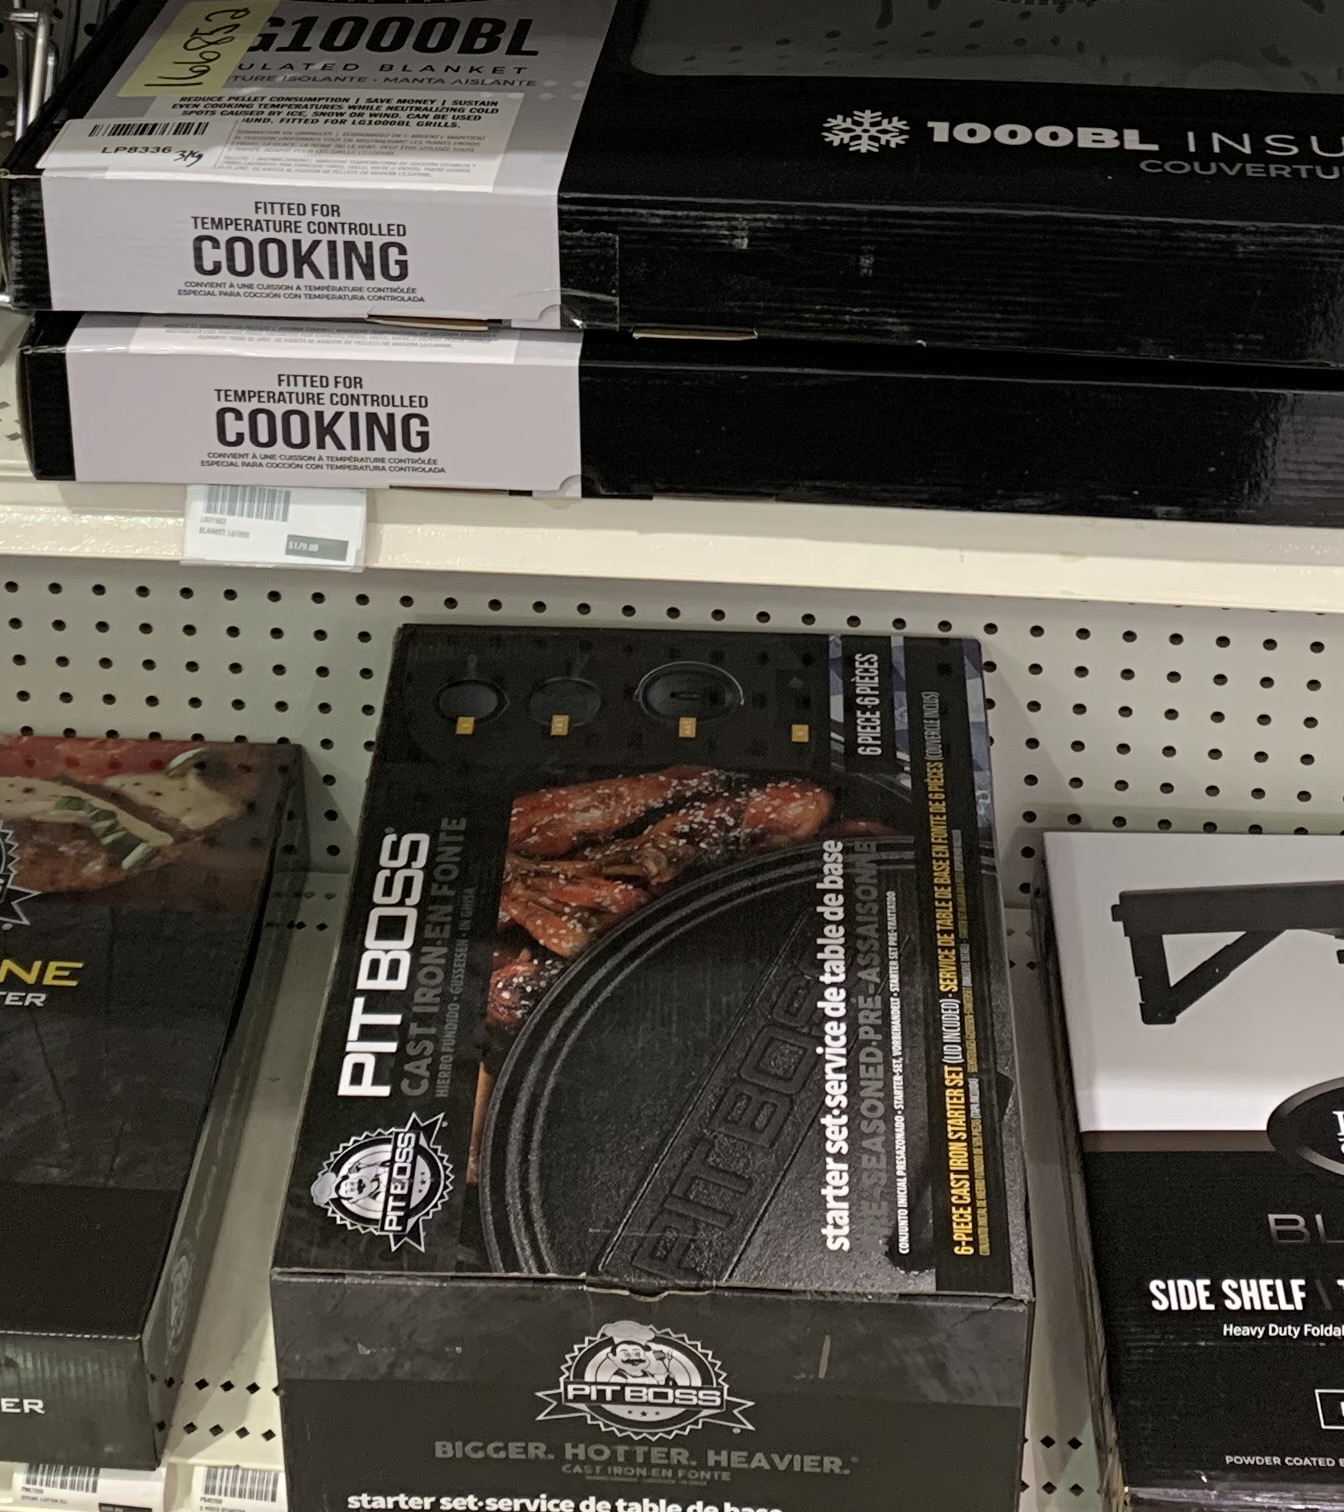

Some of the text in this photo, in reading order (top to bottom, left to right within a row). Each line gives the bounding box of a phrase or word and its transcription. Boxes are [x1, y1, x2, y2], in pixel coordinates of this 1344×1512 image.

[102, 146, 172, 155] LP8336
[926, 121, 1160, 152] 1000BL
[254, 202, 341, 217] FITTED FOR
[191, 216, 407, 237] TEMPERATURE CONTROLLED
[193, 235, 410, 281] COOKING
[337, 832, 430, 1097] PIT BOSS
[822, 1157, 849, 1251] starter
[1149, 1279, 1215, 1310] SIDE
[1221, 1279, 1305, 1310] SHELF
[1223, 1324, 1265, 1338] Heavy
[1269, 1325, 1300, 1339] Duty
[434, 1440, 851, 1474] BIGGER. HOTTER. HEAVIER.
